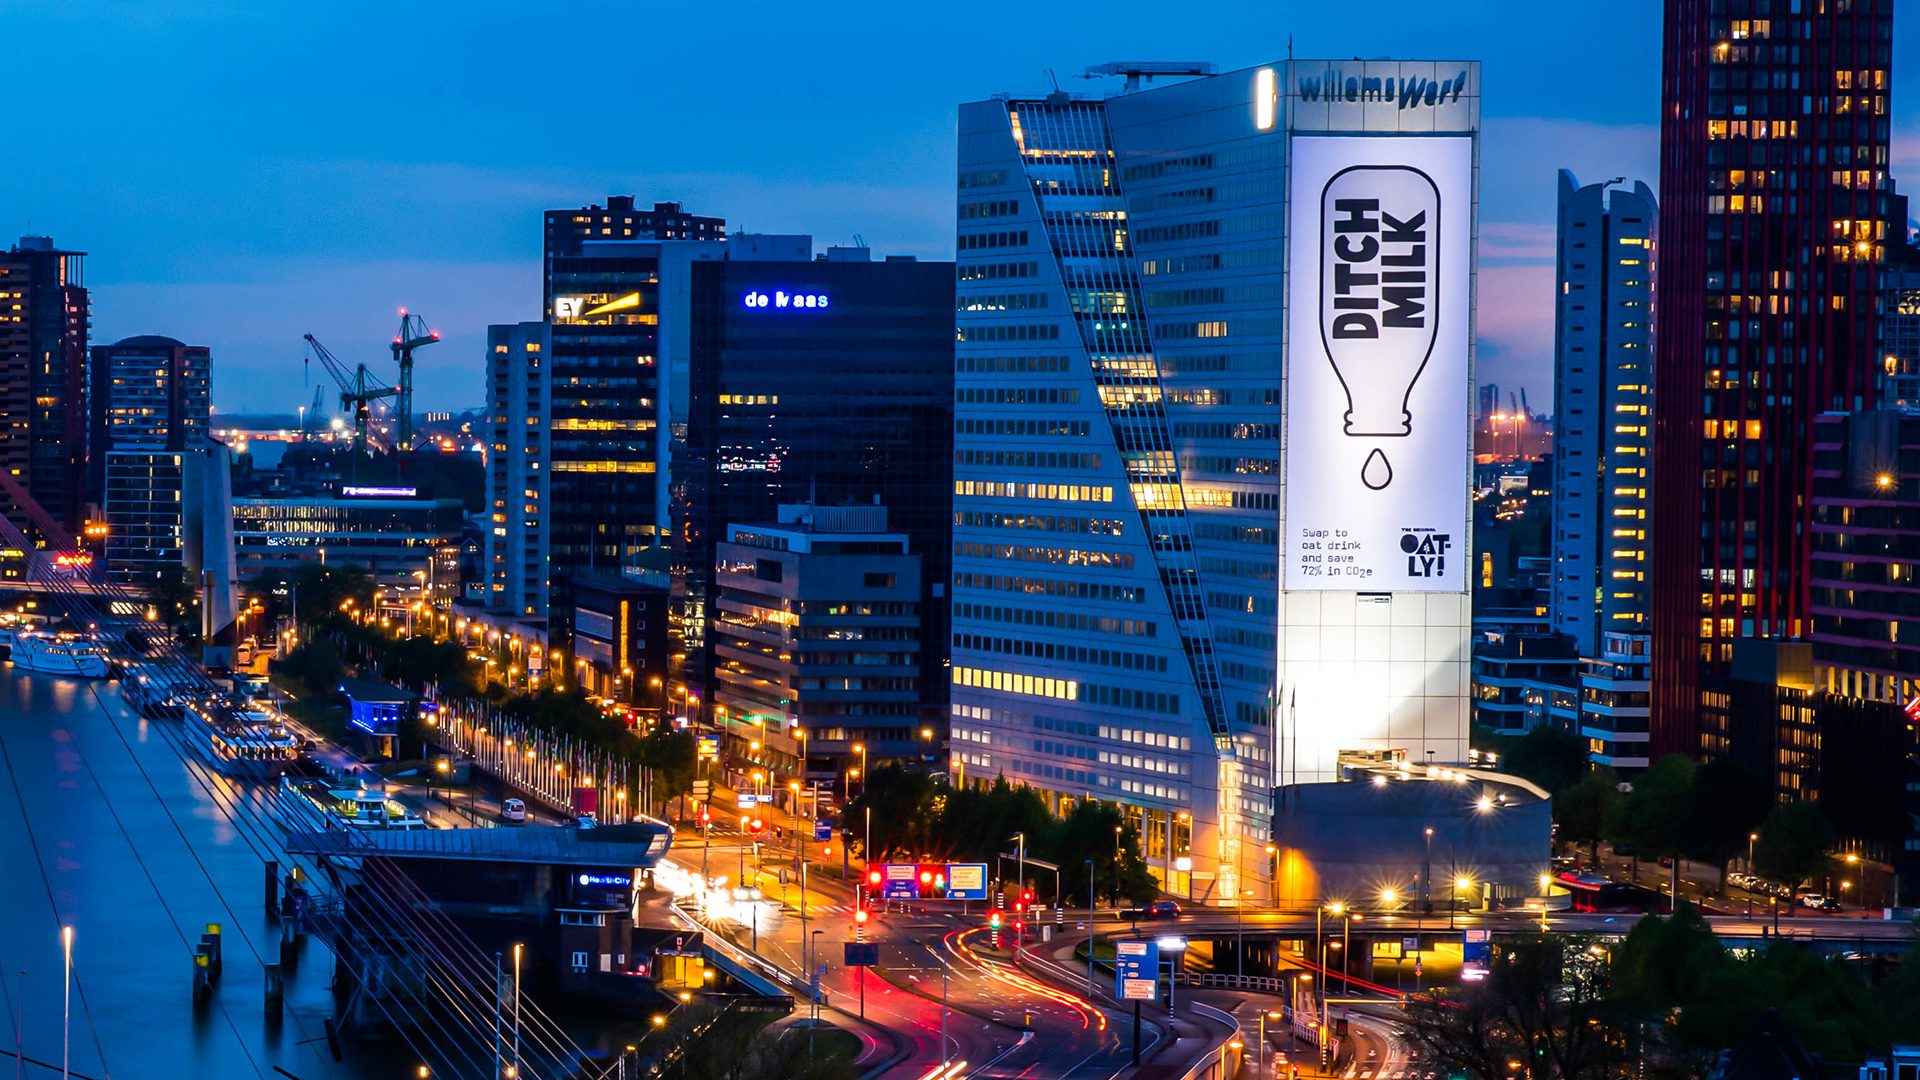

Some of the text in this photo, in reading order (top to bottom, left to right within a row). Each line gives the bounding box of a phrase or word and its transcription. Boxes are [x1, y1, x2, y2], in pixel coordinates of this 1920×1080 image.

[1333, 198, 1379, 339] DITCH
[1381, 209, 1426, 328] MILK
[555, 297, 584, 316] EY
[745, 291, 769, 307] de
[1302, 528, 1348, 539] Swap to
[1302, 540, 1361, 550] oat drink
[1301, 553, 1354, 563] and save
[1408, 555, 1445, 577] LY!
[1301, 565, 1323, 576] 72%
[1327, 566, 1341, 576] in
